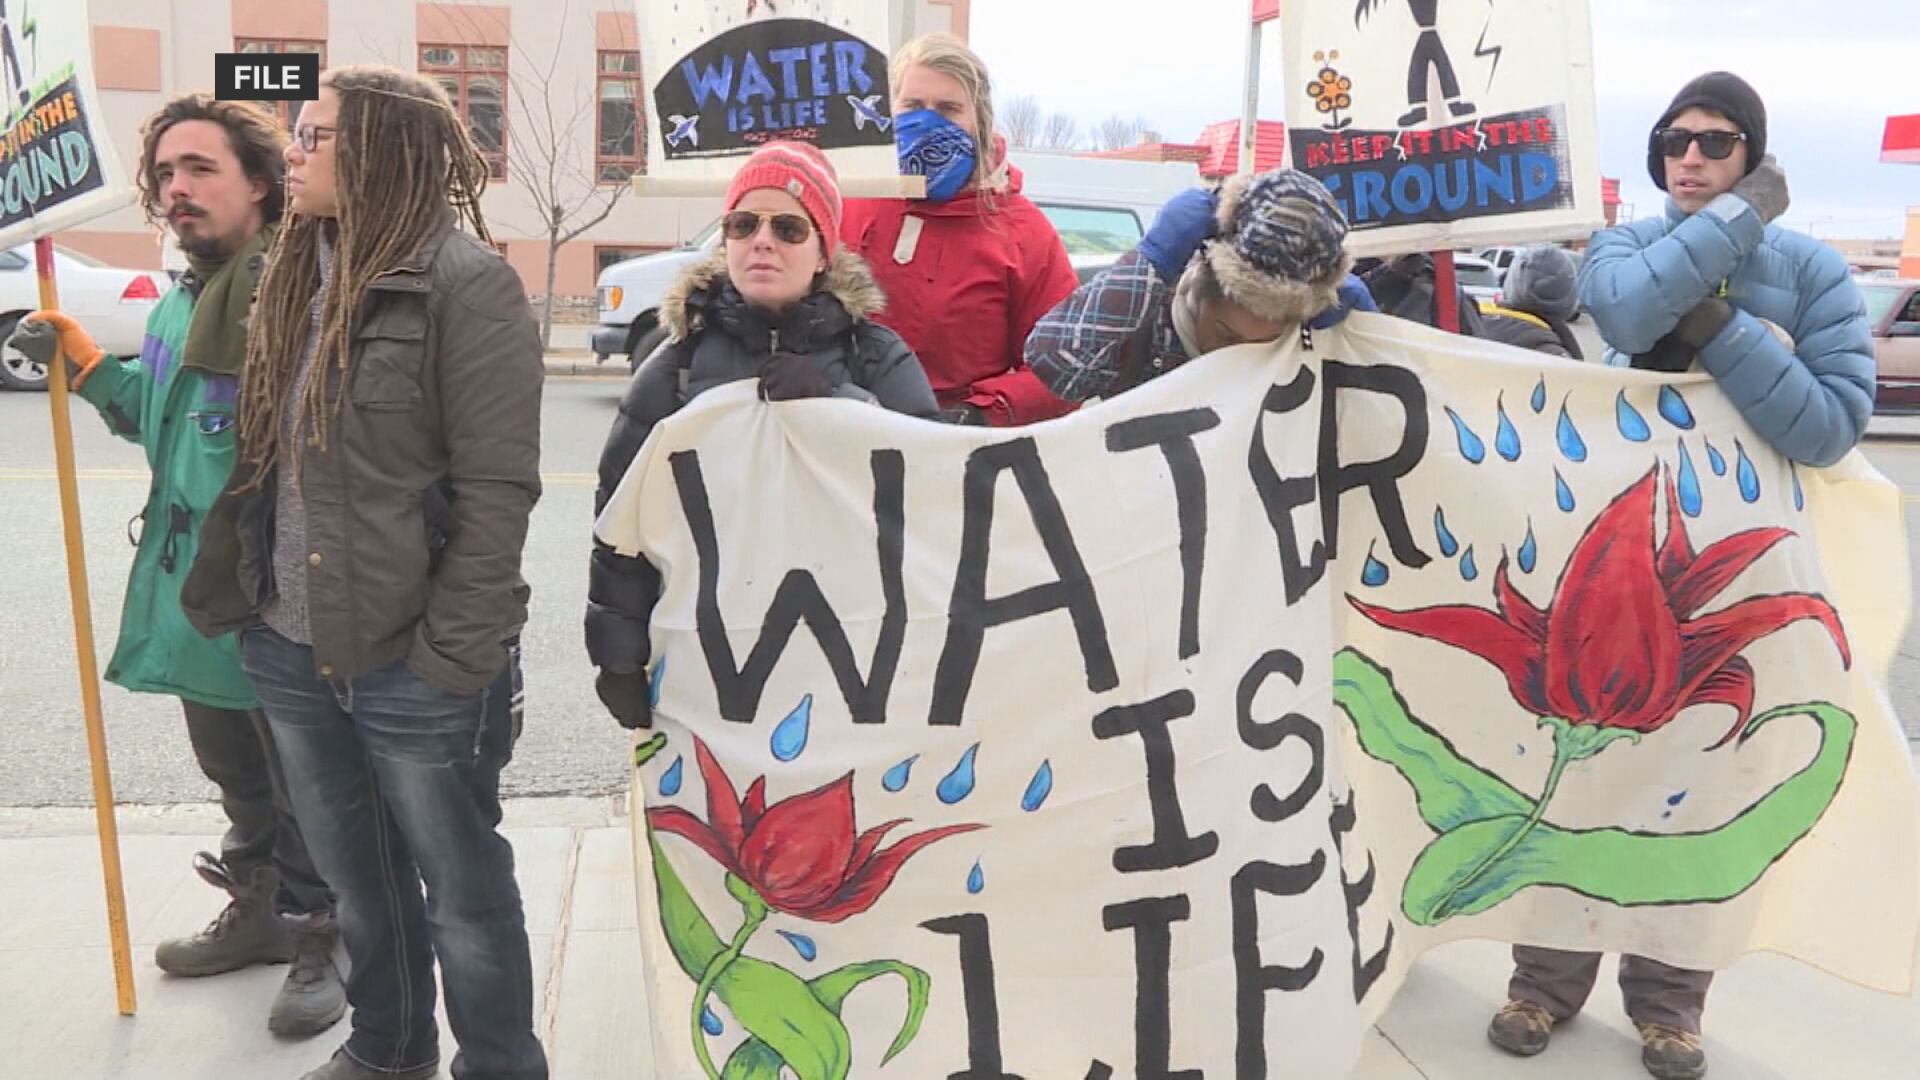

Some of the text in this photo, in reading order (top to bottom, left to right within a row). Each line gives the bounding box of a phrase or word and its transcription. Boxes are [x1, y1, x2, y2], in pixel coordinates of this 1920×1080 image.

[680, 40, 873, 106] WATER
[36, 92, 79, 132] THE
[728, 99, 827, 132] IS LIFE
[1306, 117, 1553, 168] KEEP IT IN THE
[0, 130, 90, 219] OUND
[669, 360, 1431, 726] WATER
[1092, 648, 1325, 874] IS
[918, 790, 1394, 1080] LIFE
